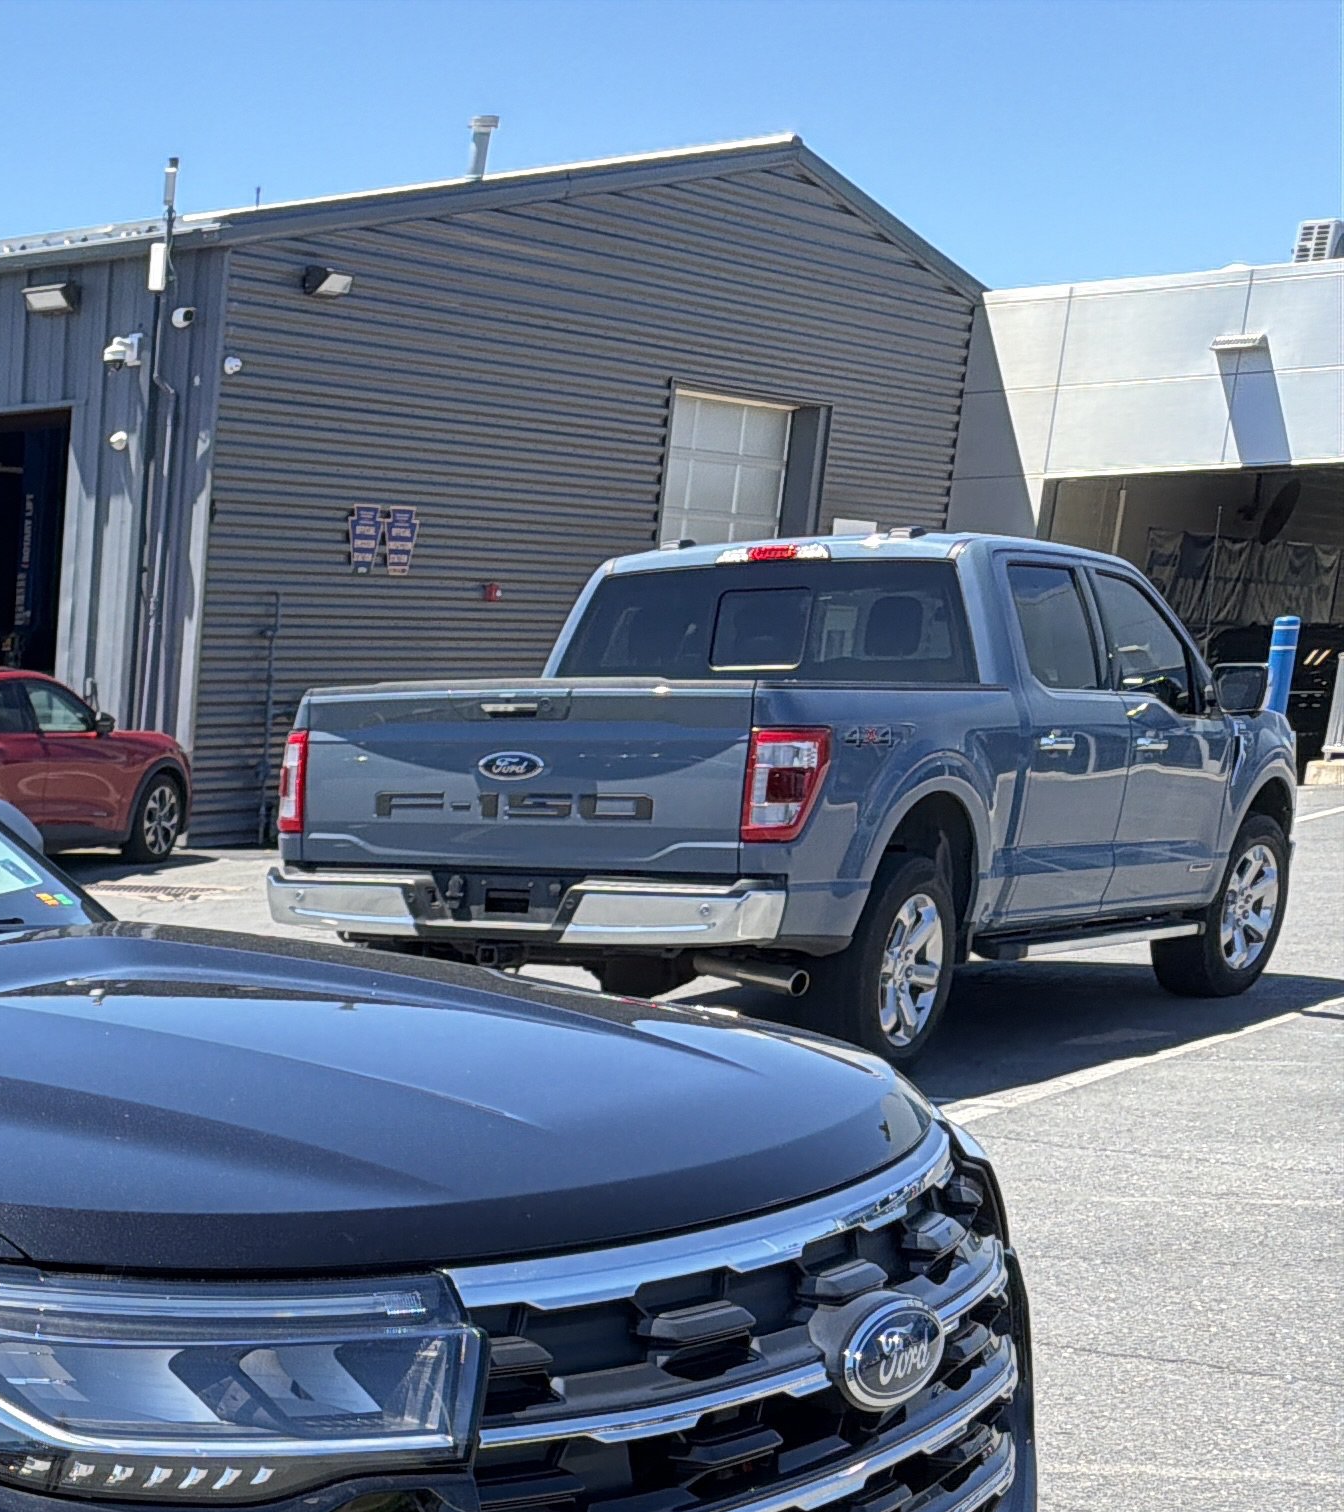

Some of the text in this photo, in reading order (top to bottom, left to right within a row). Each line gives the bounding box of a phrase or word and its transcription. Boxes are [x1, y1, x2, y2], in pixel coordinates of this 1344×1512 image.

[491, 757, 528, 774] Ford
[374, 790, 655, 821] F-150
[879, 1321, 930, 1386] Ford
